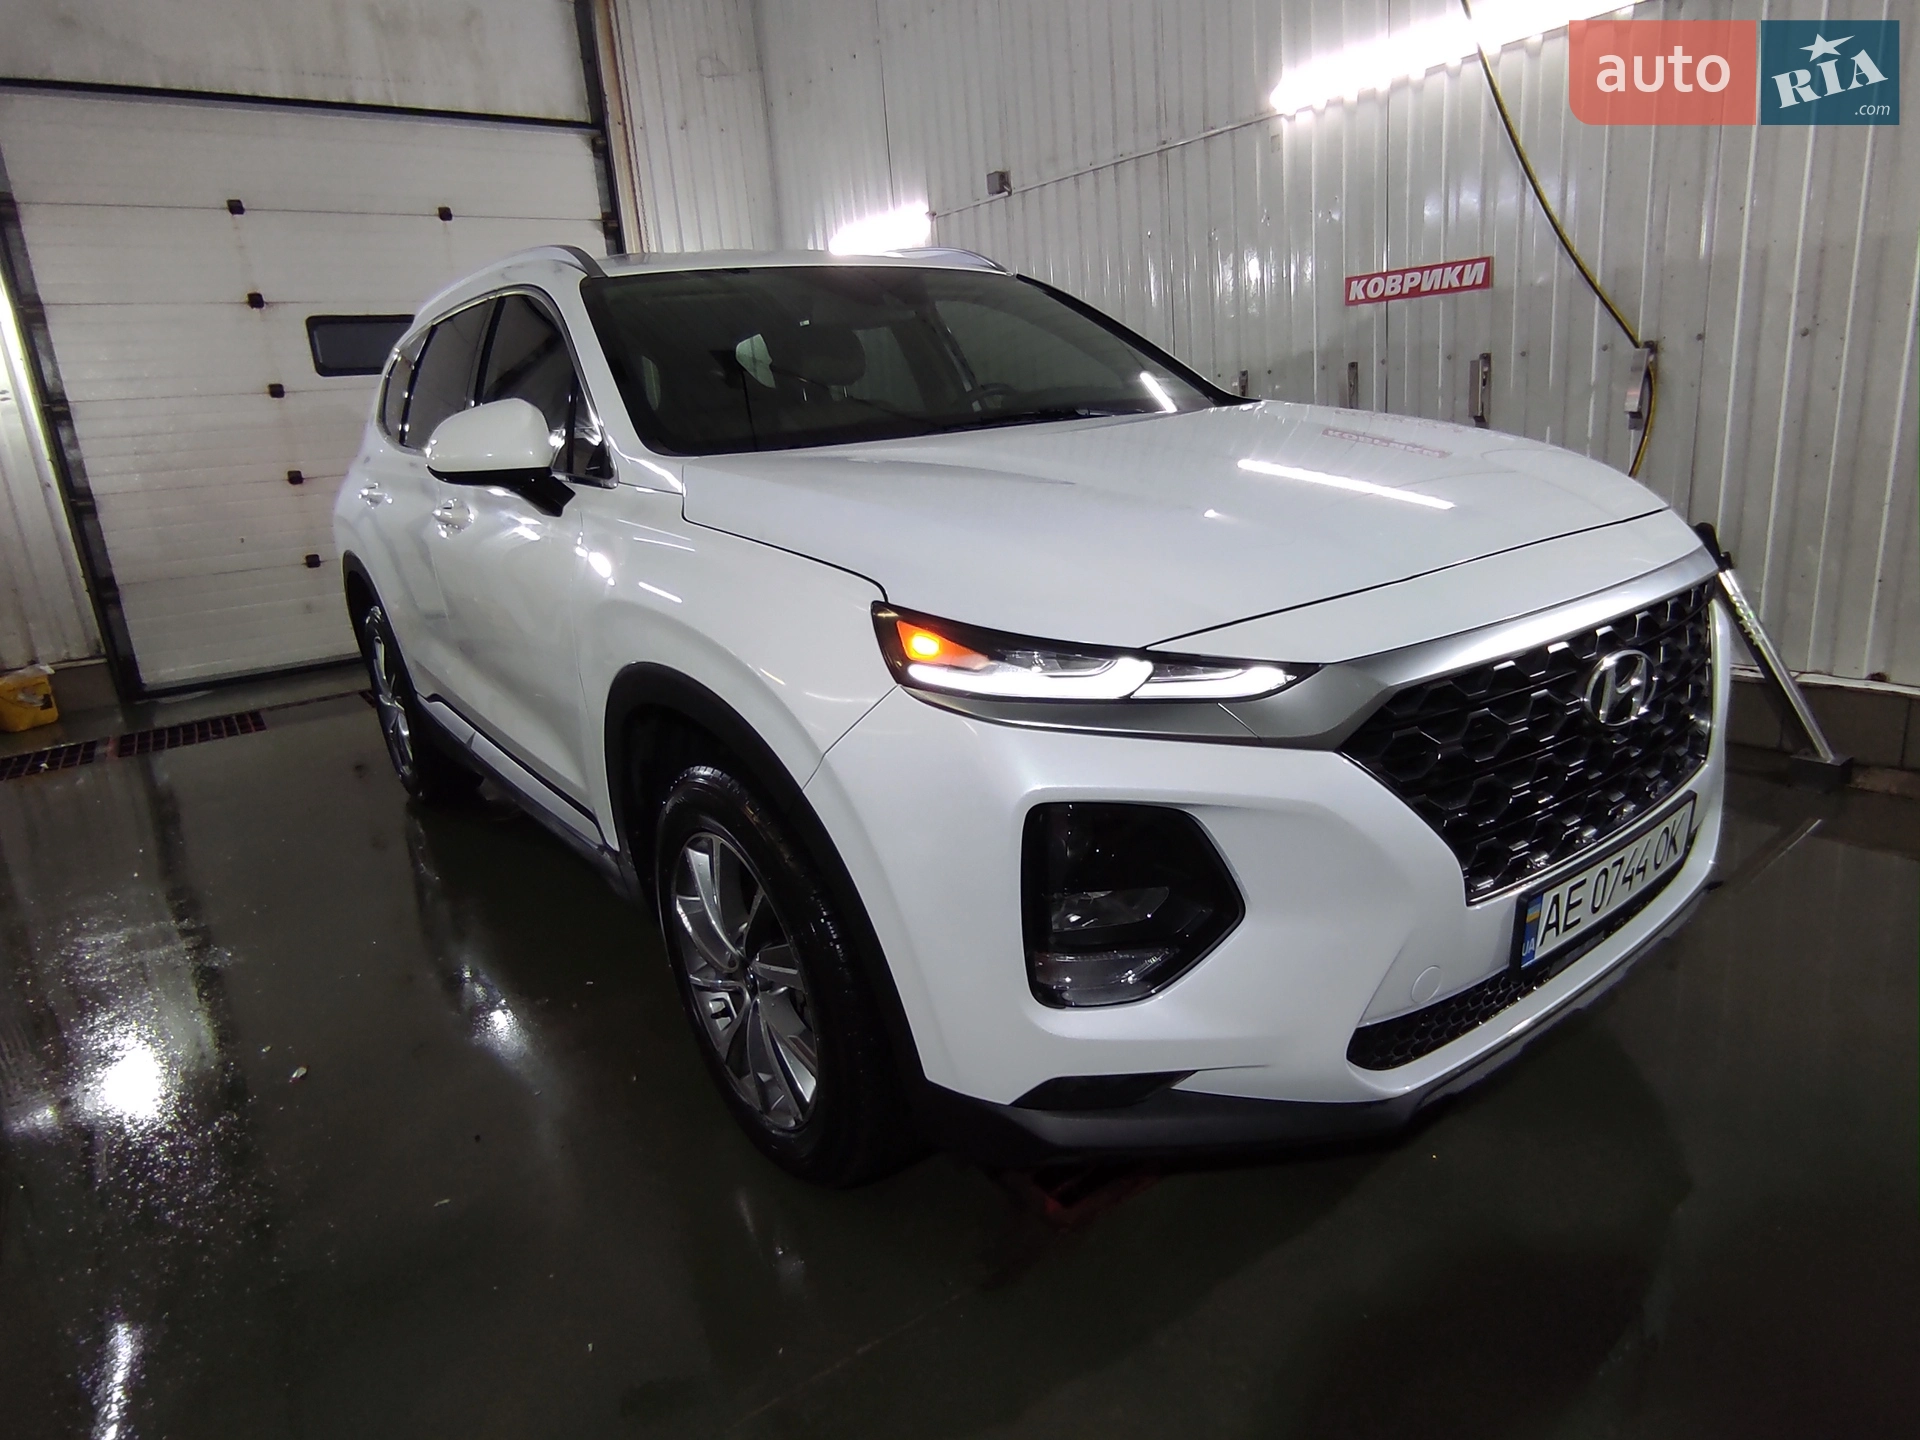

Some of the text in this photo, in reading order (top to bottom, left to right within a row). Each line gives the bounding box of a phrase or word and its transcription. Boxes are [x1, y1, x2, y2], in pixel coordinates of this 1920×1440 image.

[1348, 261, 1486, 301] КОВРИКИ
[1539, 811, 1686, 947] AE 0744 OK
[1521, 940, 1535, 957] UA
